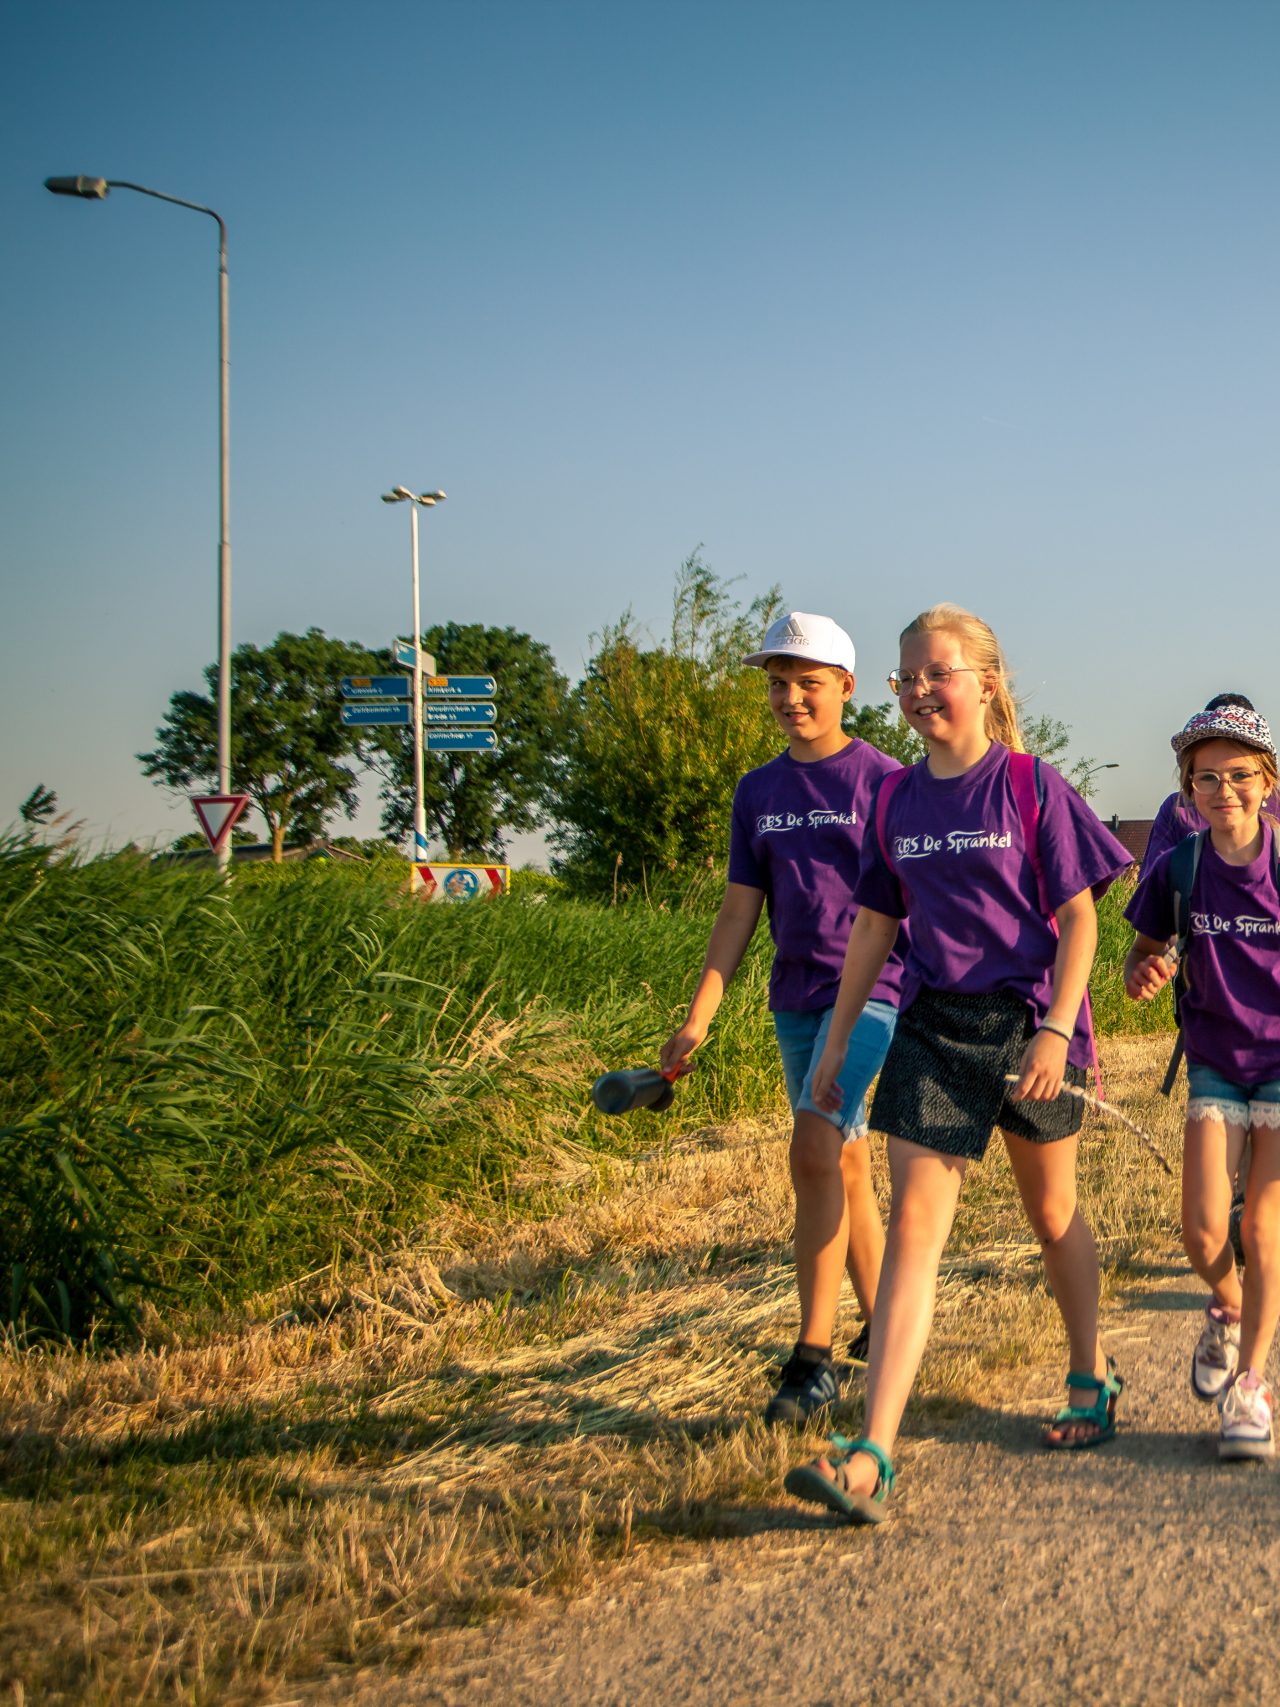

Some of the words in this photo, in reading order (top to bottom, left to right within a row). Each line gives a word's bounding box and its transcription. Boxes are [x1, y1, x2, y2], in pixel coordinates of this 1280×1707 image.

[787, 812, 804, 826] De
[807, 810, 857, 829] Sprankel
[924, 834, 942, 851] De
[945, 831, 1012, 854] Sprankel
[1213, 914, 1231, 932] De
